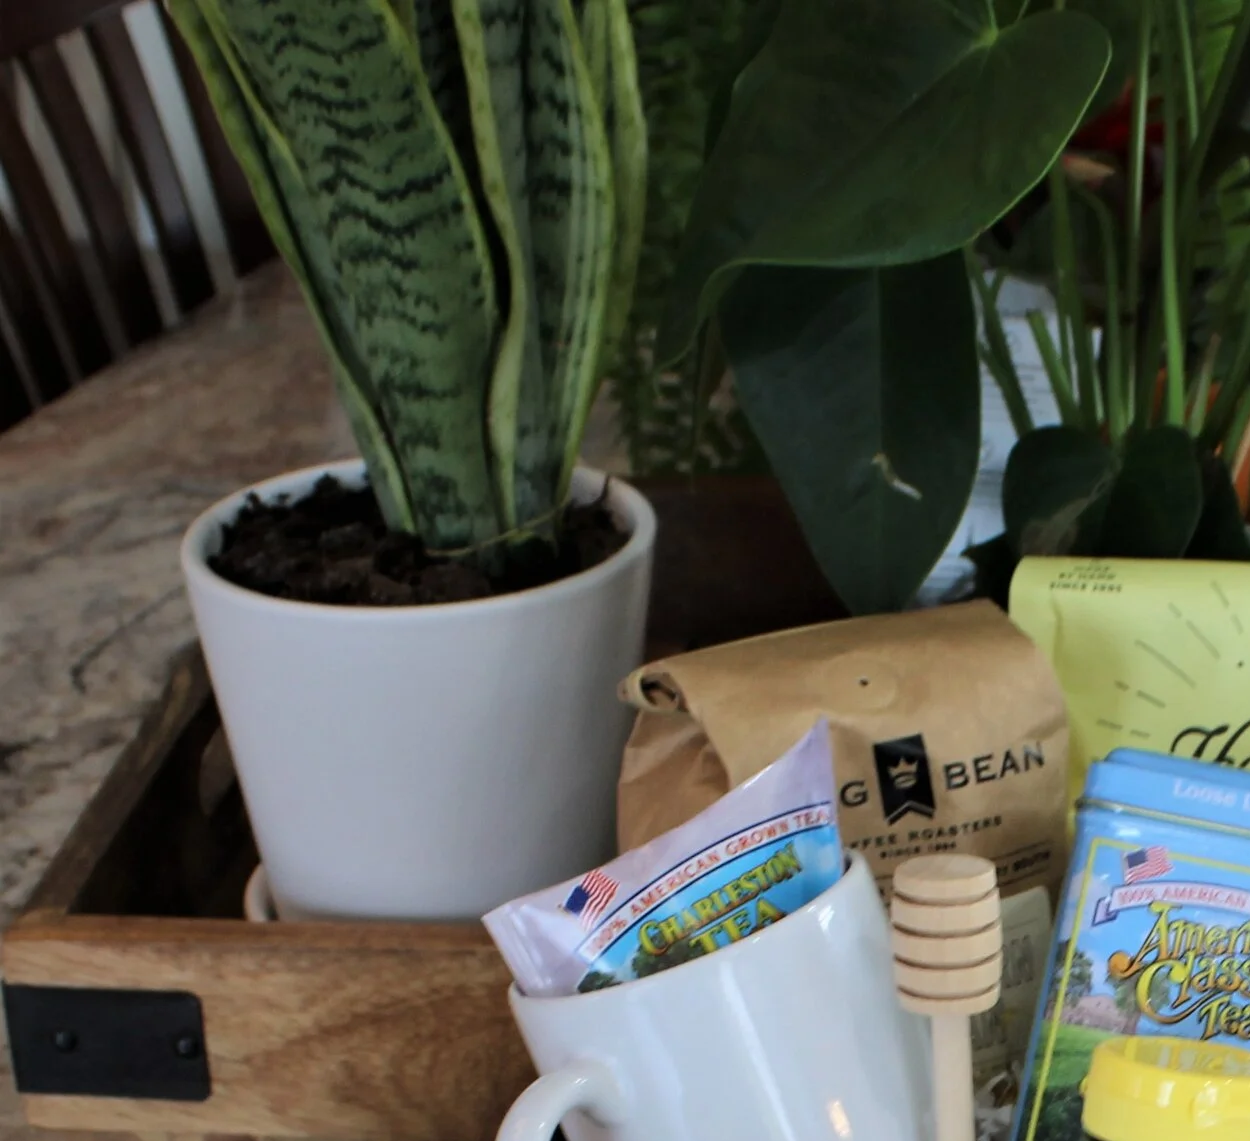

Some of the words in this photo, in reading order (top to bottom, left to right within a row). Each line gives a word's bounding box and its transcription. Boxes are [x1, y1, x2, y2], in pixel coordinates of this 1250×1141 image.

[944, 740, 1046, 791] BEAN
[1173, 777, 1237, 806] Loose
[908, 816, 1002, 842] ROASTERS
[630, 854, 721, 916] AMERICAN
[726, 822, 789, 855] GROWN
[794, 808, 829, 828] TEA
[639, 842, 803, 955] CHARLESTON
[1163, 886, 1247, 909] AMERICAN
[690, 897, 787, 953] TEA
